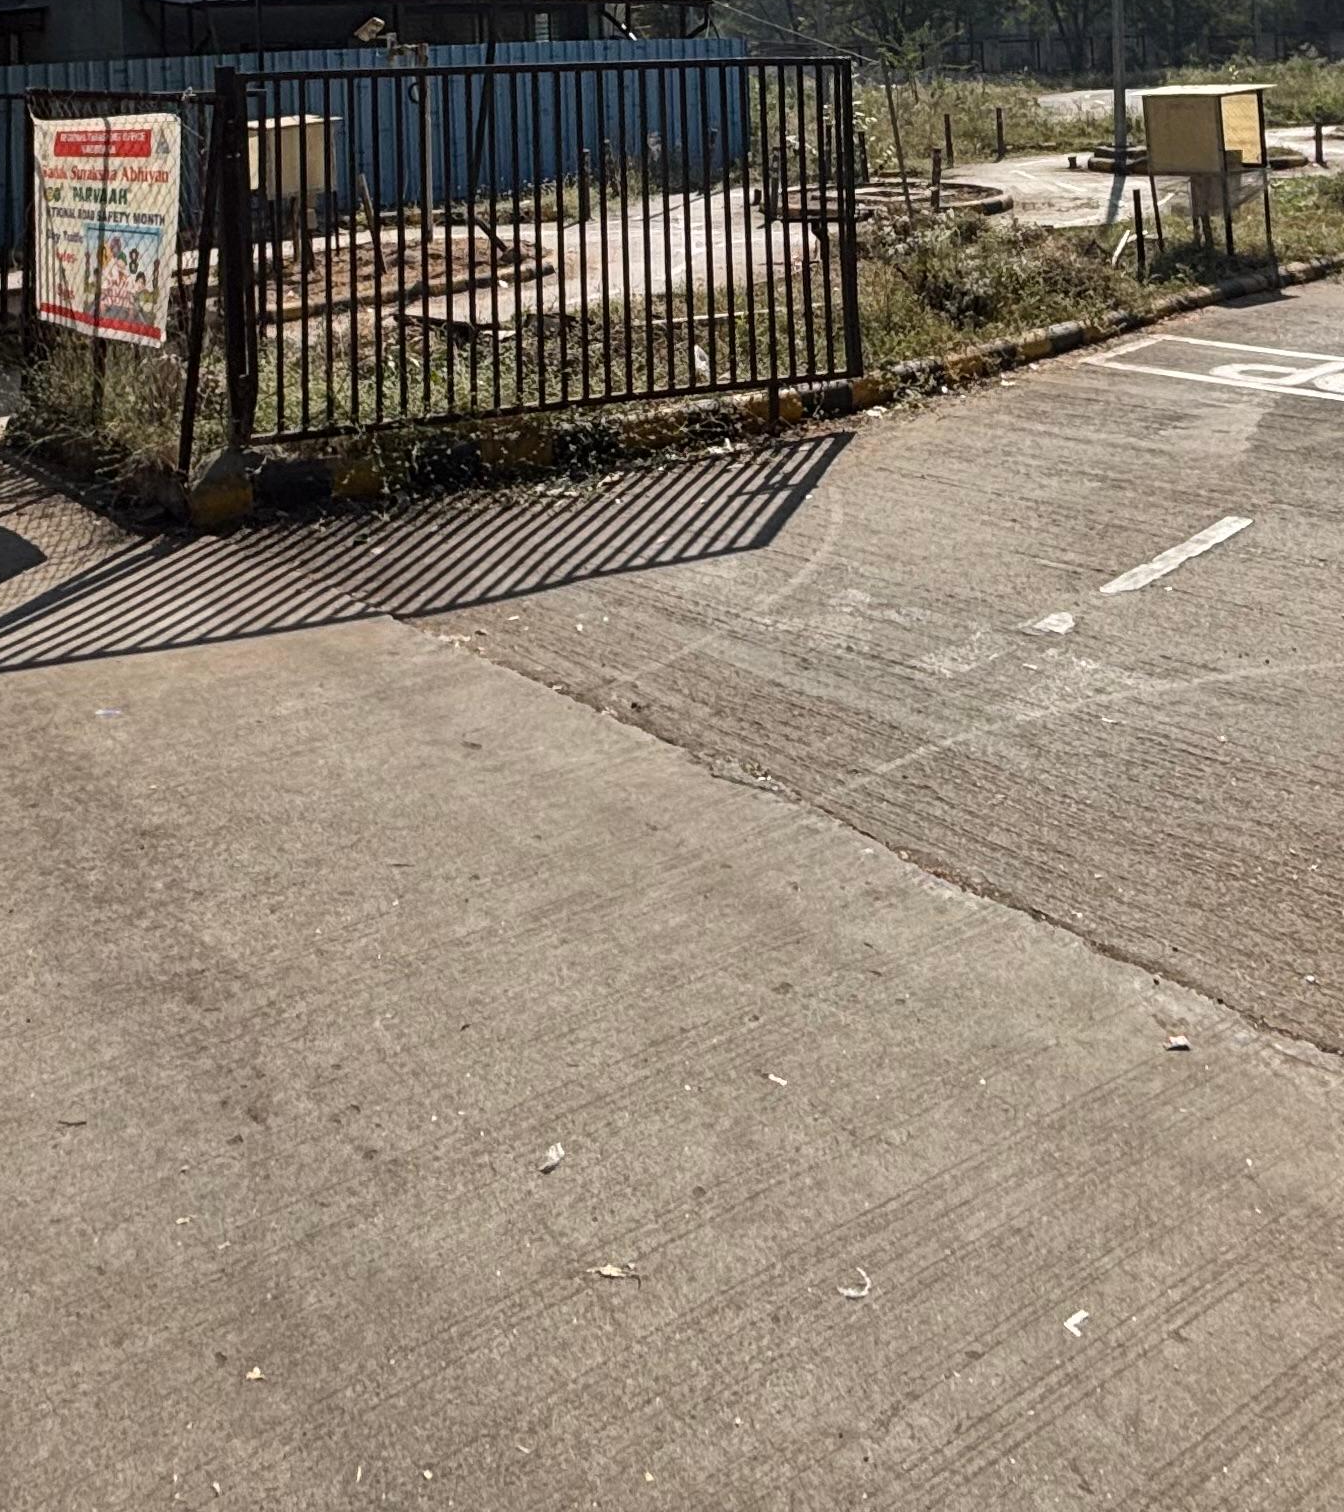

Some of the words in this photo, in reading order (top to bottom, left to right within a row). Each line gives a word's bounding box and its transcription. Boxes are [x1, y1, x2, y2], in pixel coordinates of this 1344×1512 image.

[122, 166, 169, 185] Abhiyan
[97, 210, 131, 224] SAFETY
[133, 212, 166, 226] MONTH
